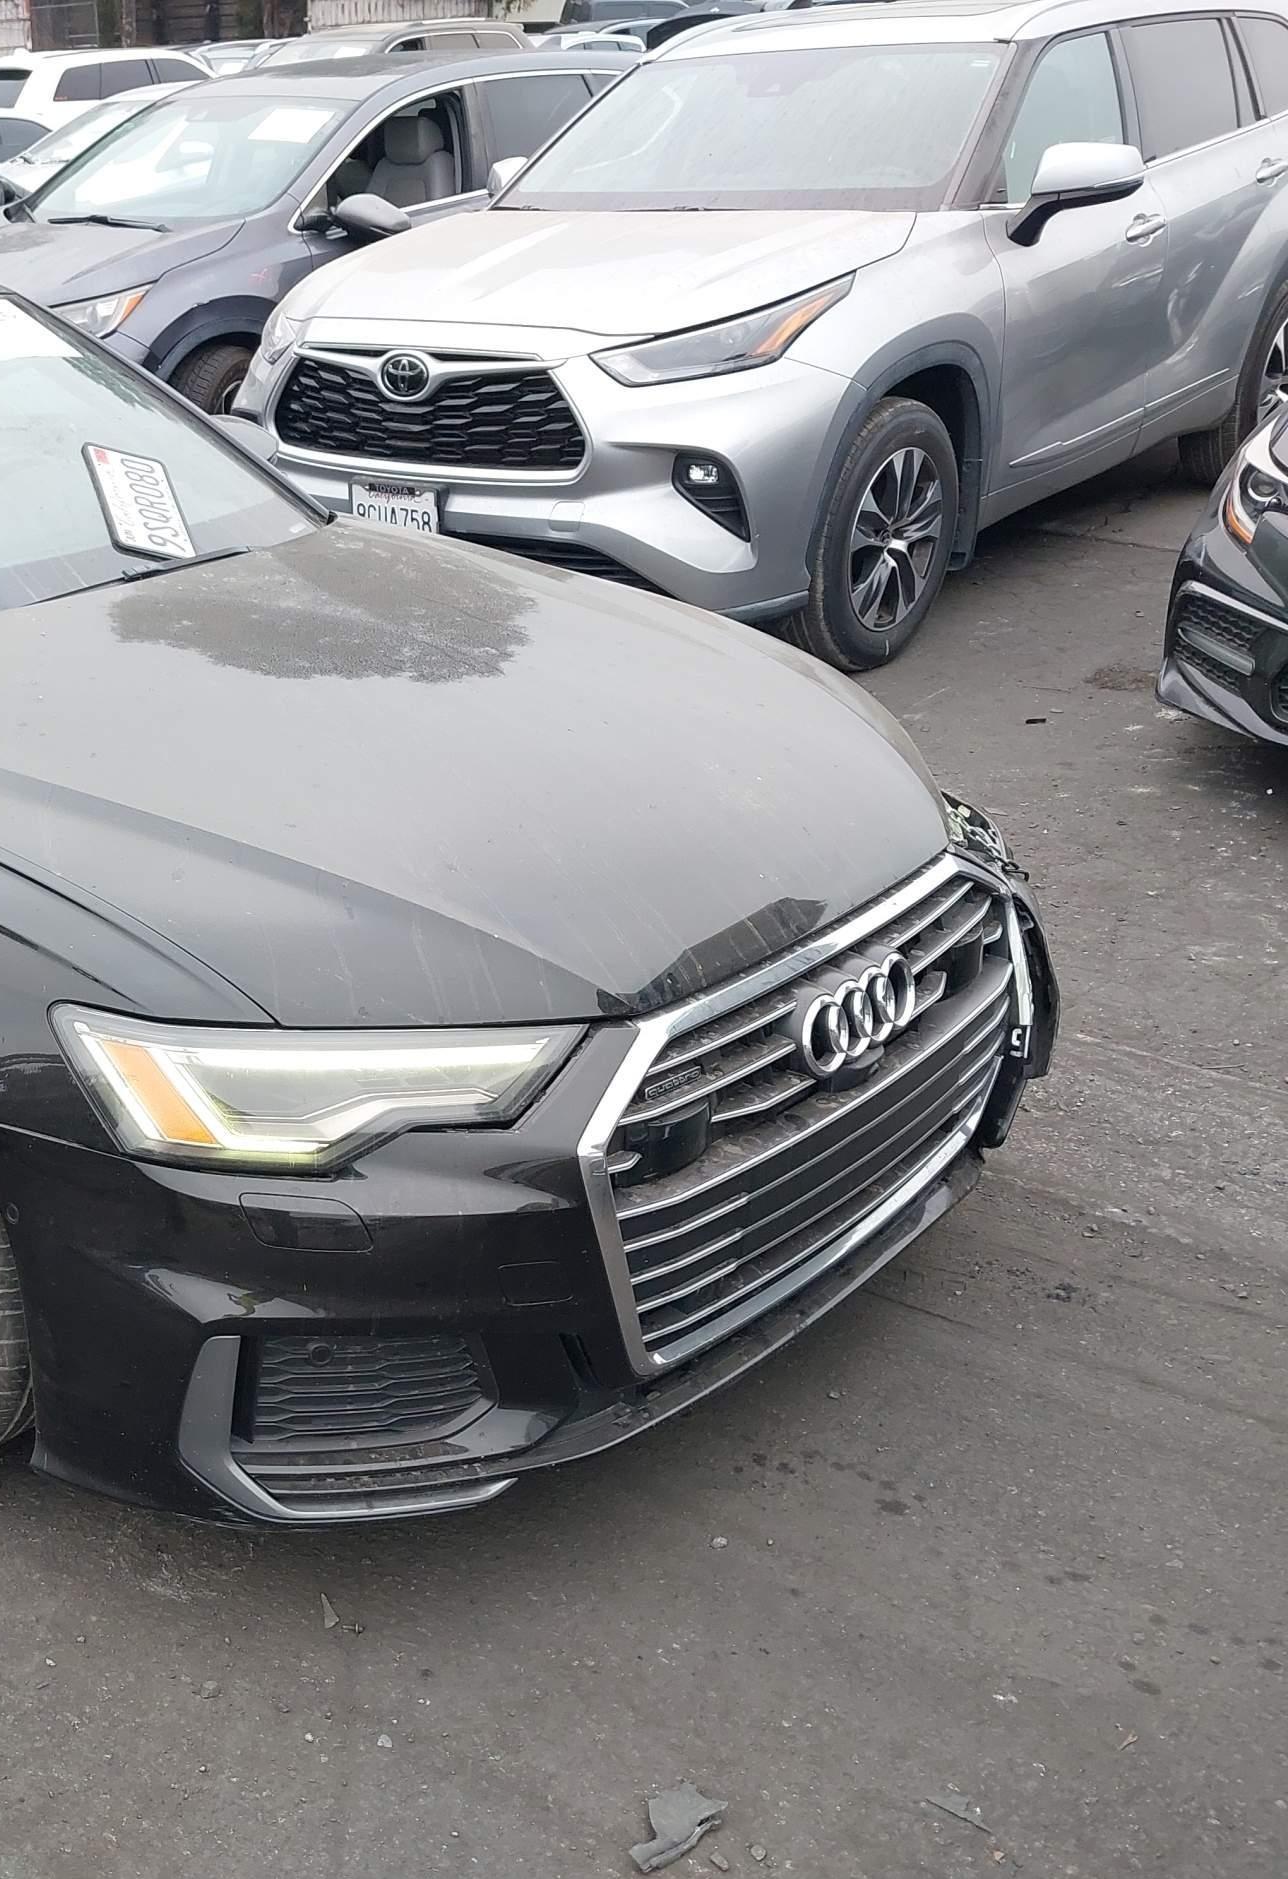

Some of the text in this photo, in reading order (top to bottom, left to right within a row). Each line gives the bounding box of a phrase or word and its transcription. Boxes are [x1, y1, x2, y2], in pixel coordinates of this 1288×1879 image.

[375, 484, 409, 494] TOYOTA
[121, 458, 187, 552] 9SQR080
[648, 1070, 700, 1097] quattro
